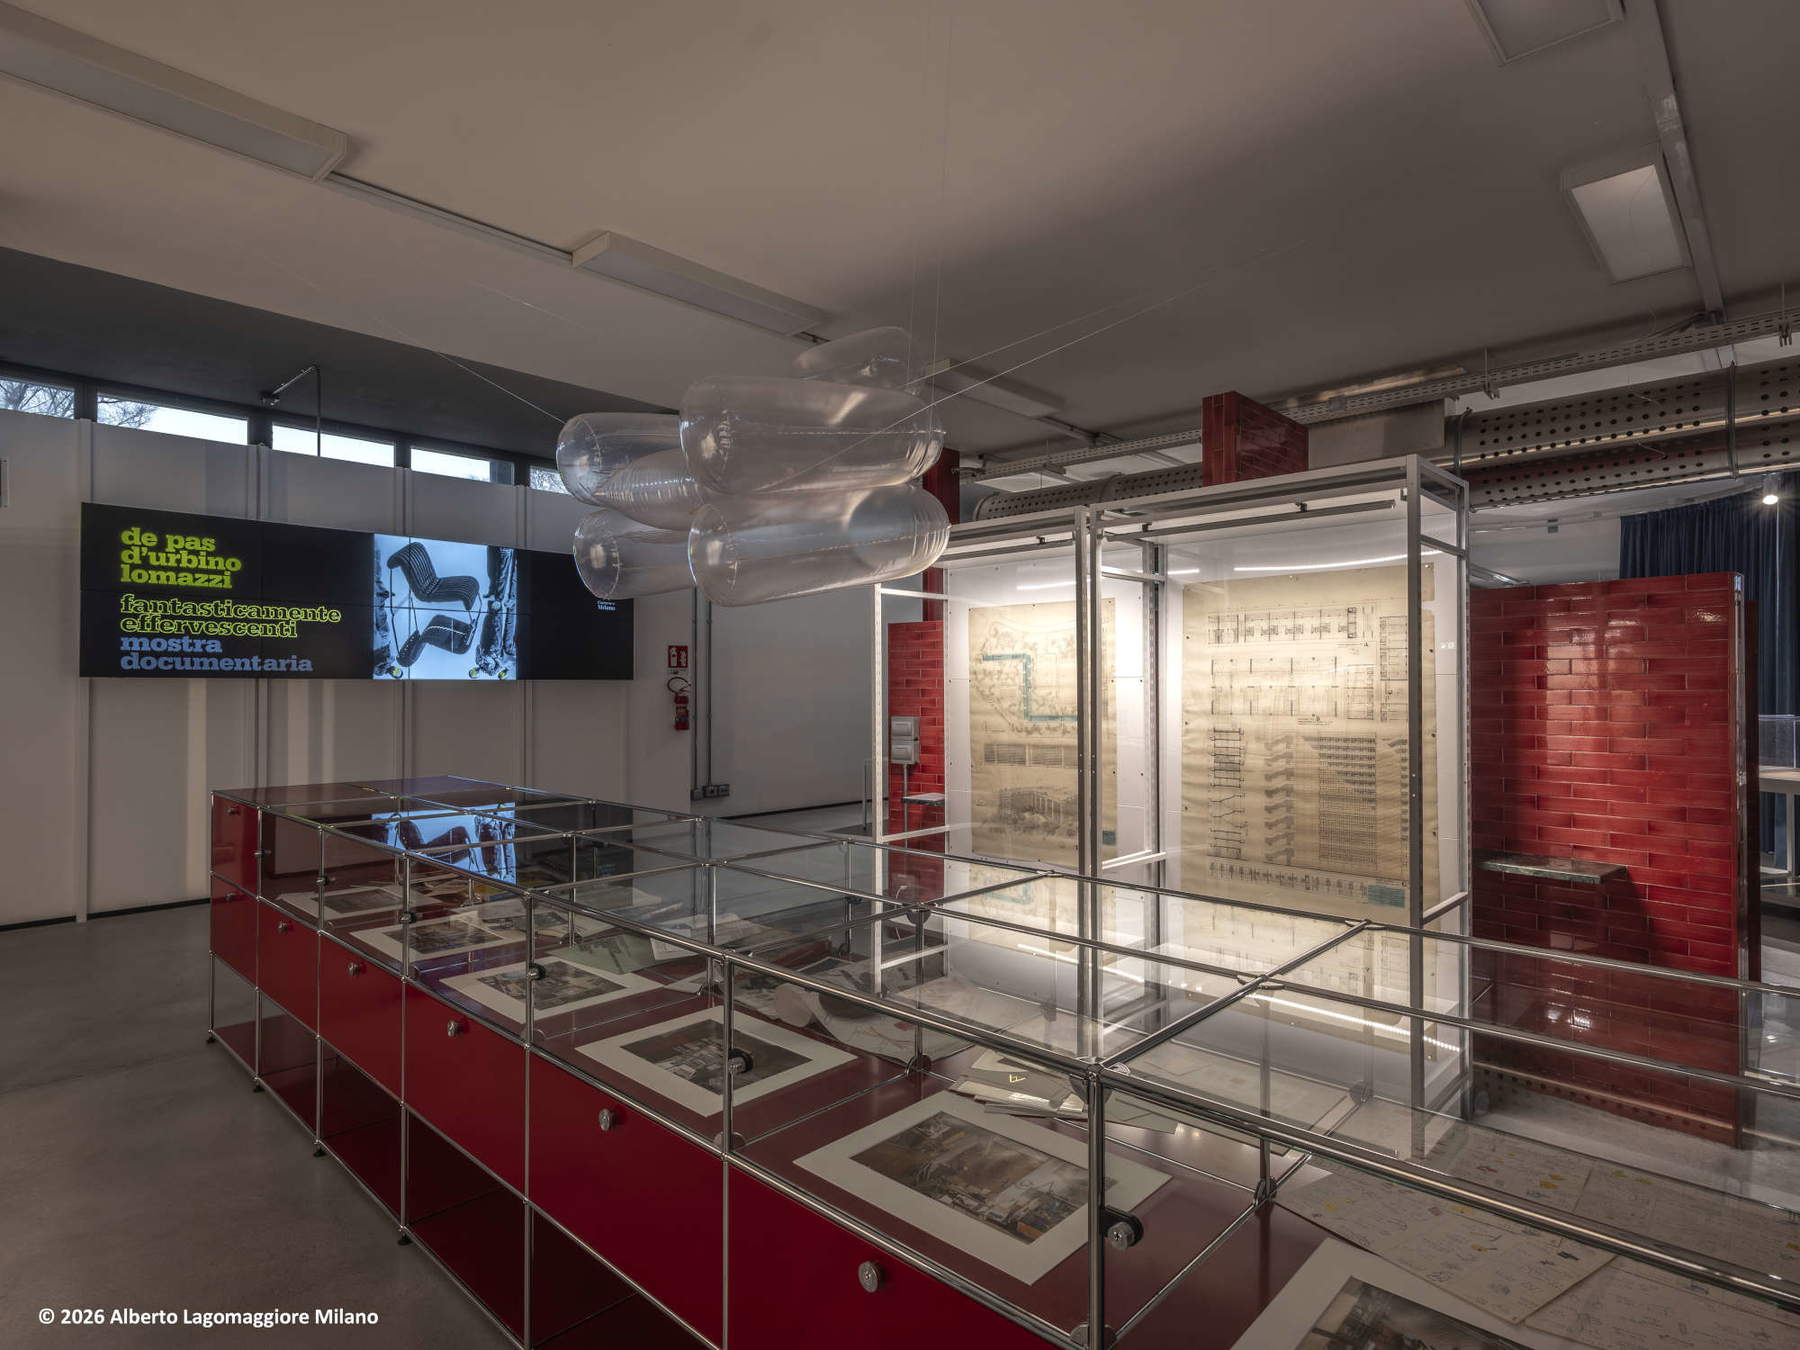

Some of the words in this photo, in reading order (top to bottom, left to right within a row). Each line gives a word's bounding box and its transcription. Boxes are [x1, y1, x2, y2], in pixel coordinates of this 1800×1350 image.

[120, 527, 158, 547] de
[165, 534, 217, 552] pas
[120, 547, 243, 572] d'urbino
[120, 565, 233, 589] lomazzi
[120, 594, 342, 623] fantasticamente
[120, 615, 298, 638] effervescenti
[120, 636, 223, 653] mostra
[120, 652, 314, 673] documentaria
